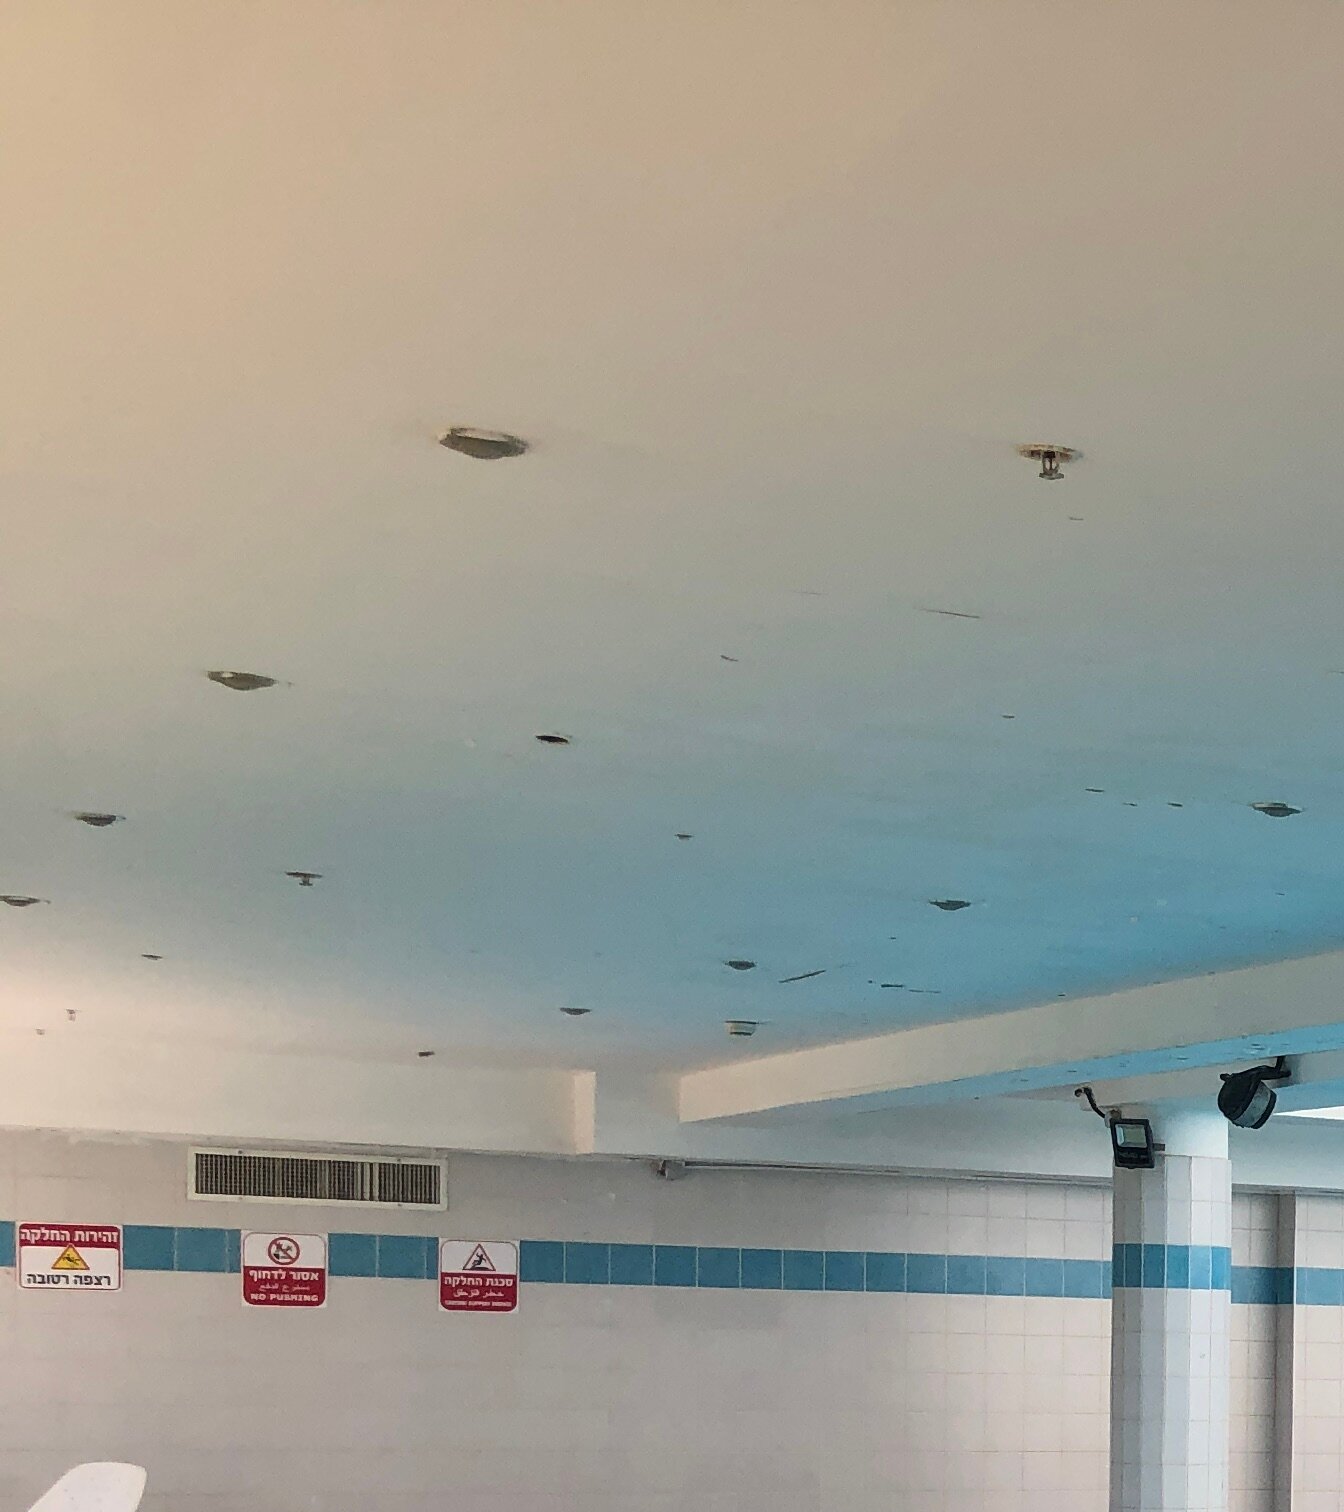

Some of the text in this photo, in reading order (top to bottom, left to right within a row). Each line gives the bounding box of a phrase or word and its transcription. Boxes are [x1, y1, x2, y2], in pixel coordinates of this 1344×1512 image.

[20, 1227, 118, 1244] זהירות החלקה
[26, 1273, 111, 1286] רצפה רטובה
[249, 1269, 319, 1282] אסור לדחוף
[444, 1276, 514, 1288] סכנת החלקה
[250, 1293, 319, 1302] NO PUSHING
